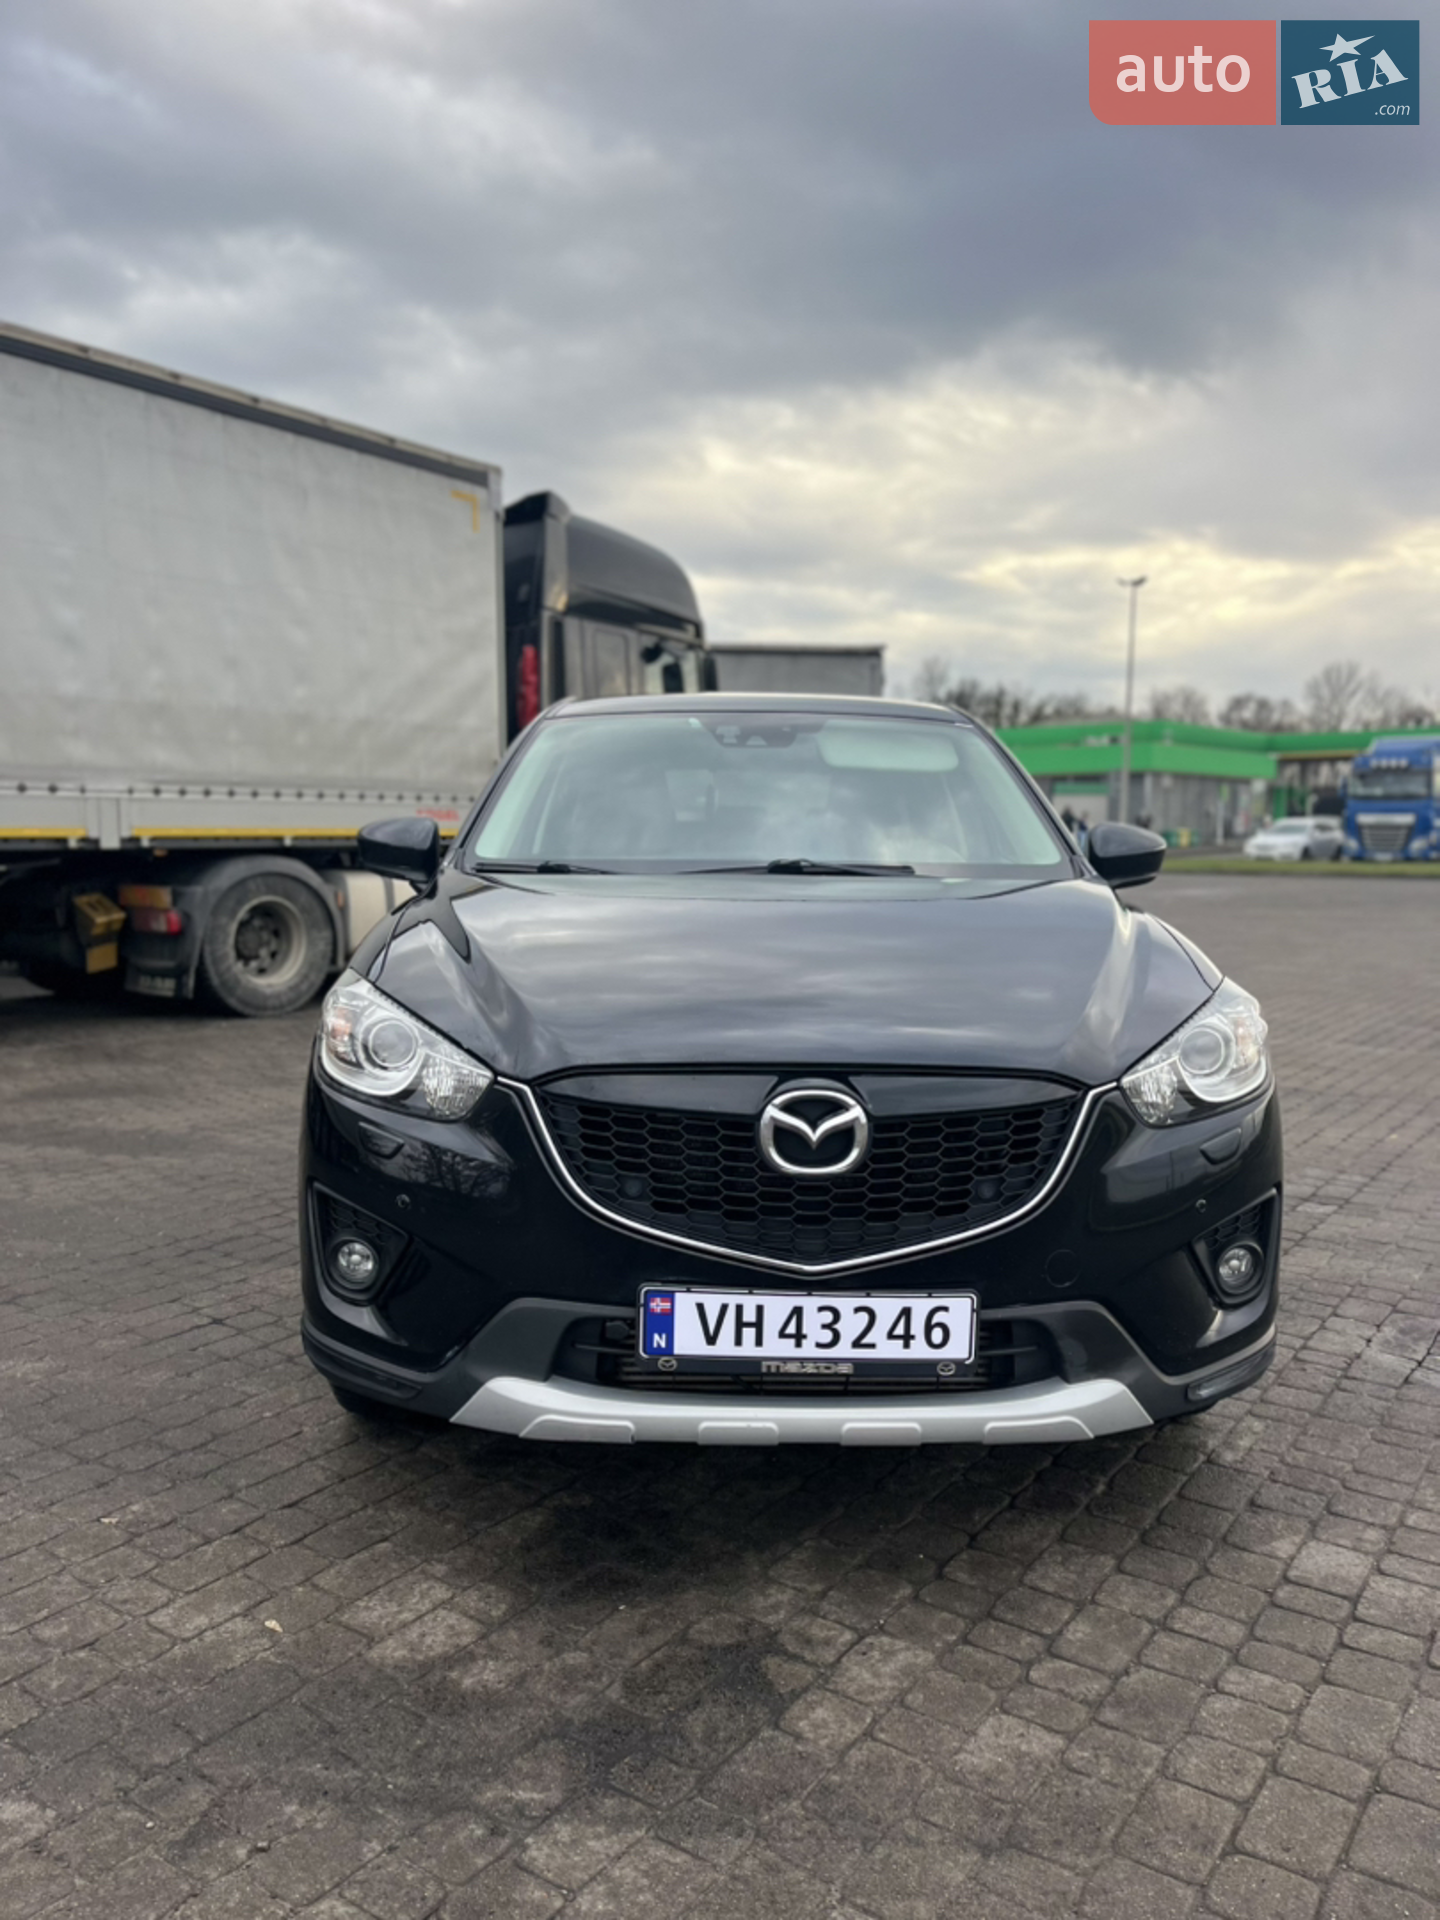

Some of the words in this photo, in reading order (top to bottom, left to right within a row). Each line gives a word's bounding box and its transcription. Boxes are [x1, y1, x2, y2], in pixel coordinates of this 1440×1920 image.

[695, 1302, 765, 1348] VH
[778, 1305, 951, 1350] 43246
[652, 1333, 667, 1349] N
[761, 1361, 854, 1374] mazda
